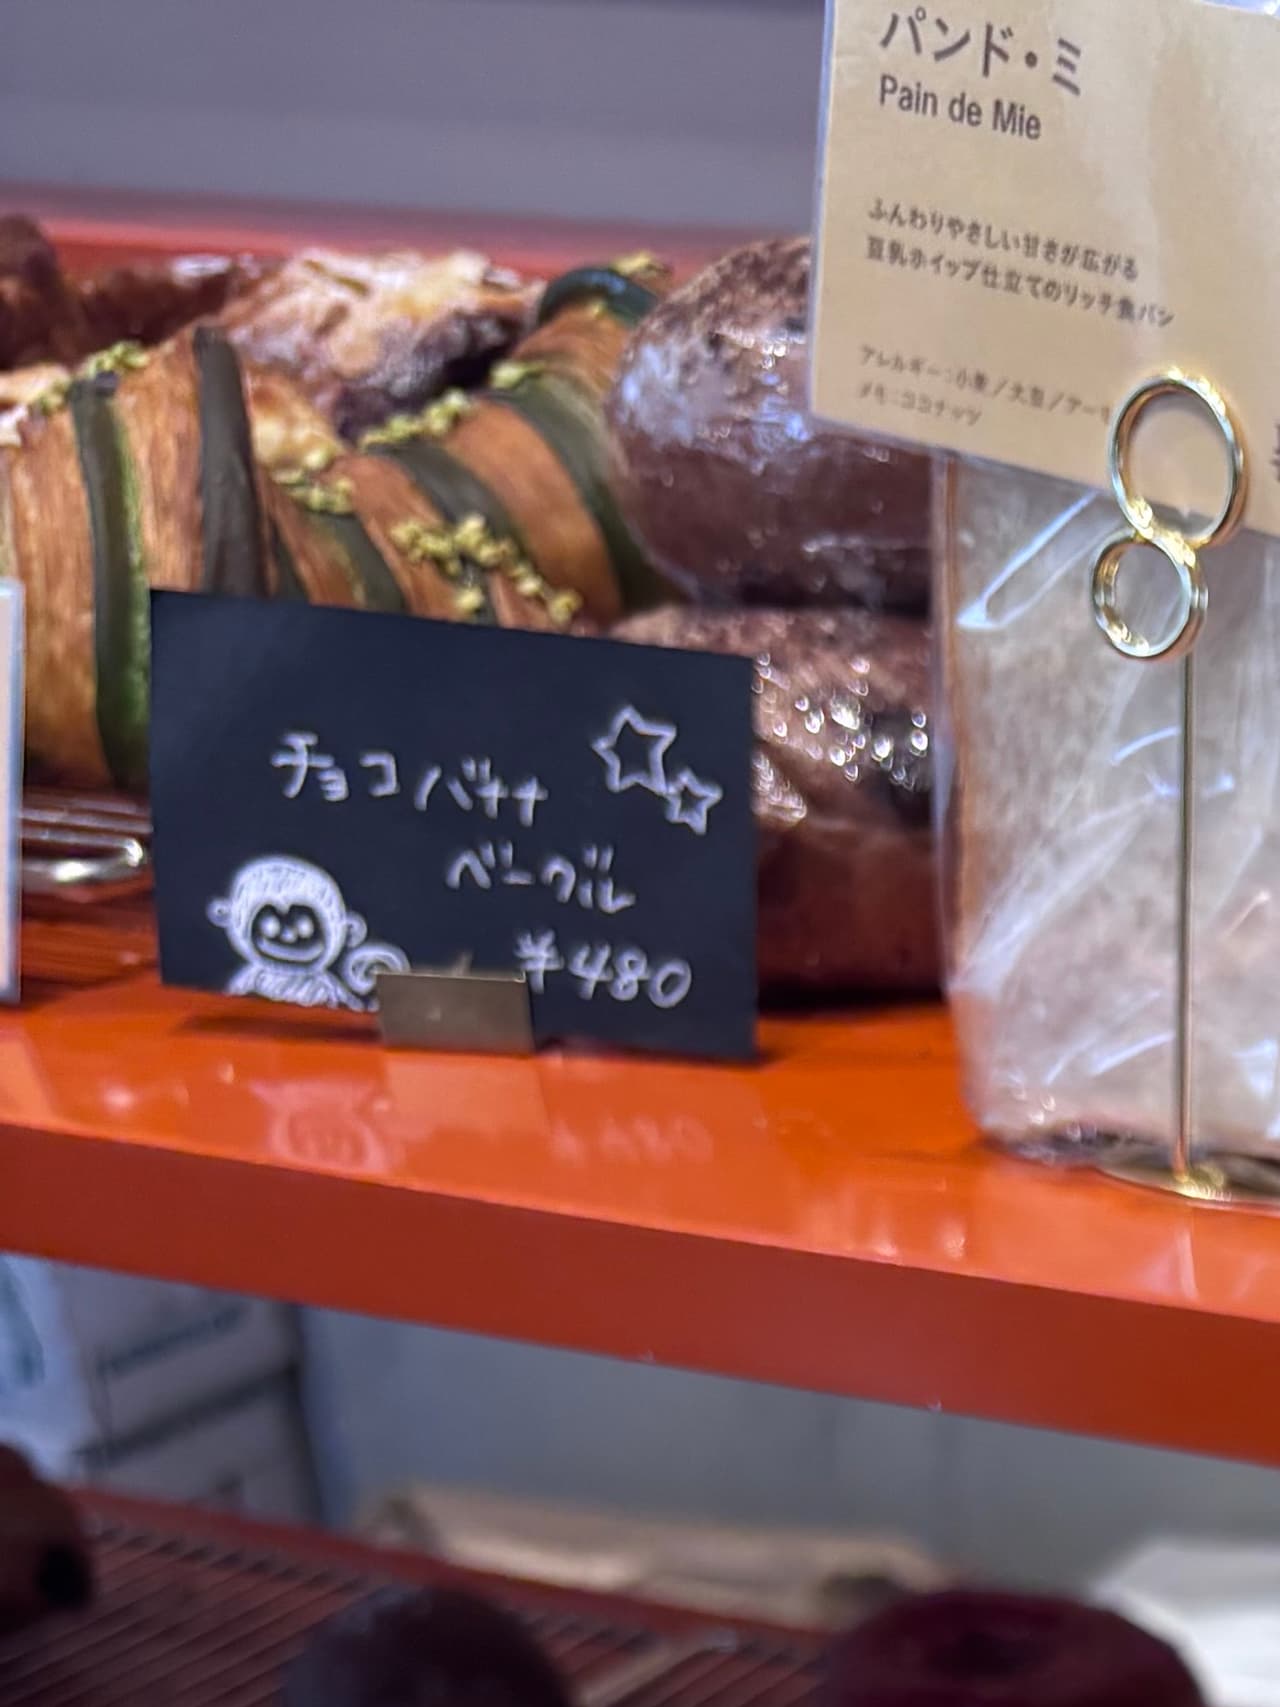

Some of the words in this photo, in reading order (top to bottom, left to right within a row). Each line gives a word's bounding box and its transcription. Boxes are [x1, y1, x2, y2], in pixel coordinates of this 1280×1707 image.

[880, 5, 1082, 97] パンド・ミ
[880, 73, 938, 118] Pain
[948, 91, 983, 127] de
[992, 98, 1042, 141] Mie
[868, 198, 1138, 281] ふんわりやさしい甘さが広がる
[271, 732, 548, 827] チョコバナナ
[445, 842, 636, 913] ベーグル
[512, 930, 692, 1008] ¥480
